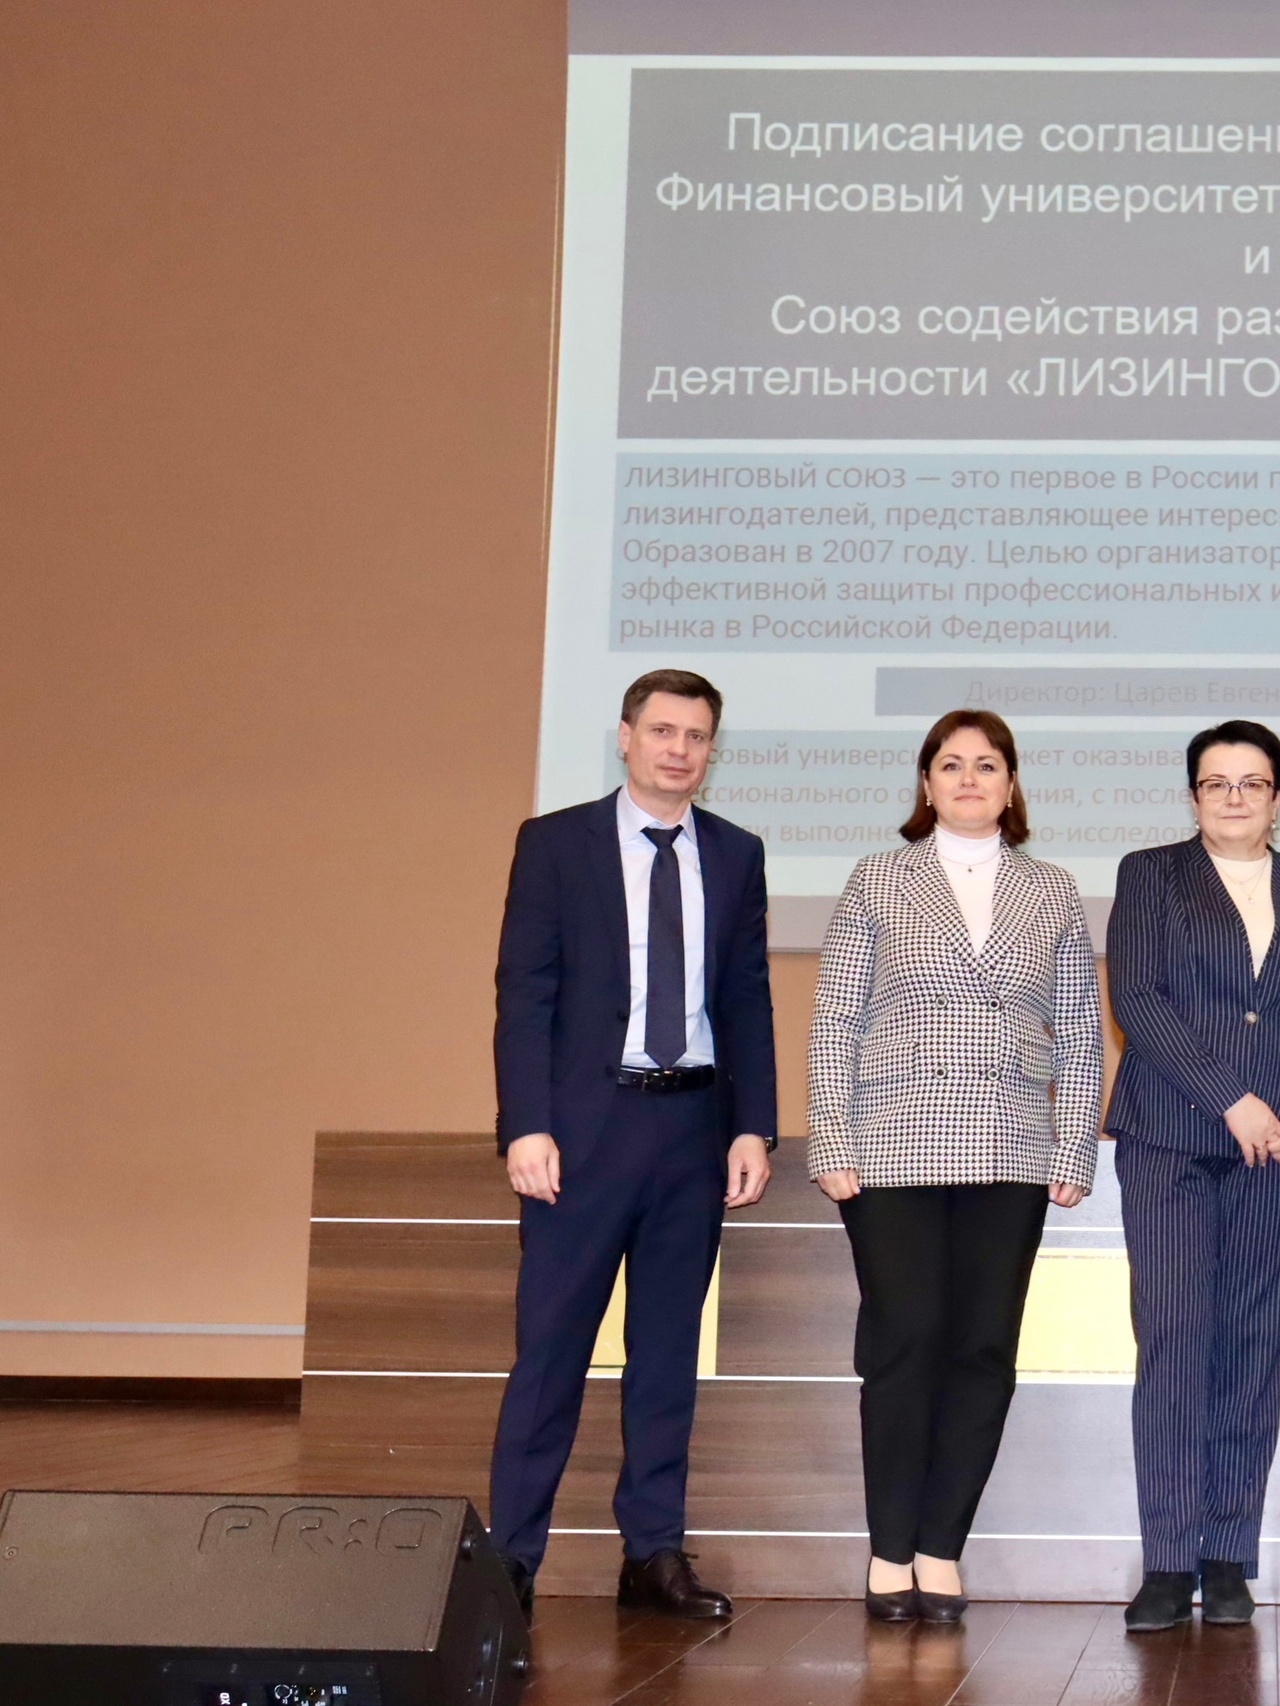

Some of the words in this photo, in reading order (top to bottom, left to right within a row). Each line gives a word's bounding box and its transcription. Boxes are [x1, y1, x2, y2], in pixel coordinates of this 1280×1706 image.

[727, 112, 1023, 158] Подписание
[656, 171, 964, 213] Финансовый
[981, 183, 1280, 222] университет
[1245, 246, 1270, 274] и
[771, 295, 901, 336] Союз
[918, 296, 1198, 341] содействия
[647, 365, 987, 403] деятельности
[951, 470, 1000, 488] это
[1011, 470, 1116, 494] первое
[1127, 471, 1142, 489] в
[1152, 466, 1259, 489] России
[623, 502, 876, 530] лизингодателей,
[886, 506, 1148, 532] представляющее
[623, 538, 785, 568] Образован
[796, 545, 813, 563] в
[822, 539, 893, 564] 2007
[904, 545, 976, 569] году.
[987, 540, 1087, 568] Целью
[621, 577, 826, 606] эффективной
[837, 581, 955, 604] защиты
[965, 577, 1261, 606] профессиональных
[620, 617, 715, 643] рынка
[725, 619, 741, 638] в
[751, 614, 932, 639] Российской
[942, 614, 1117, 644] Федерации.
[964, 681, 1104, 707] Директор:
[1115, 682, 1198, 706] Царев
[798, 748, 920, 770] универси
[1019, 750, 1064, 766] жет
[1072, 750, 1185, 766] оказыва
[781, 825, 898, 842] выполне
